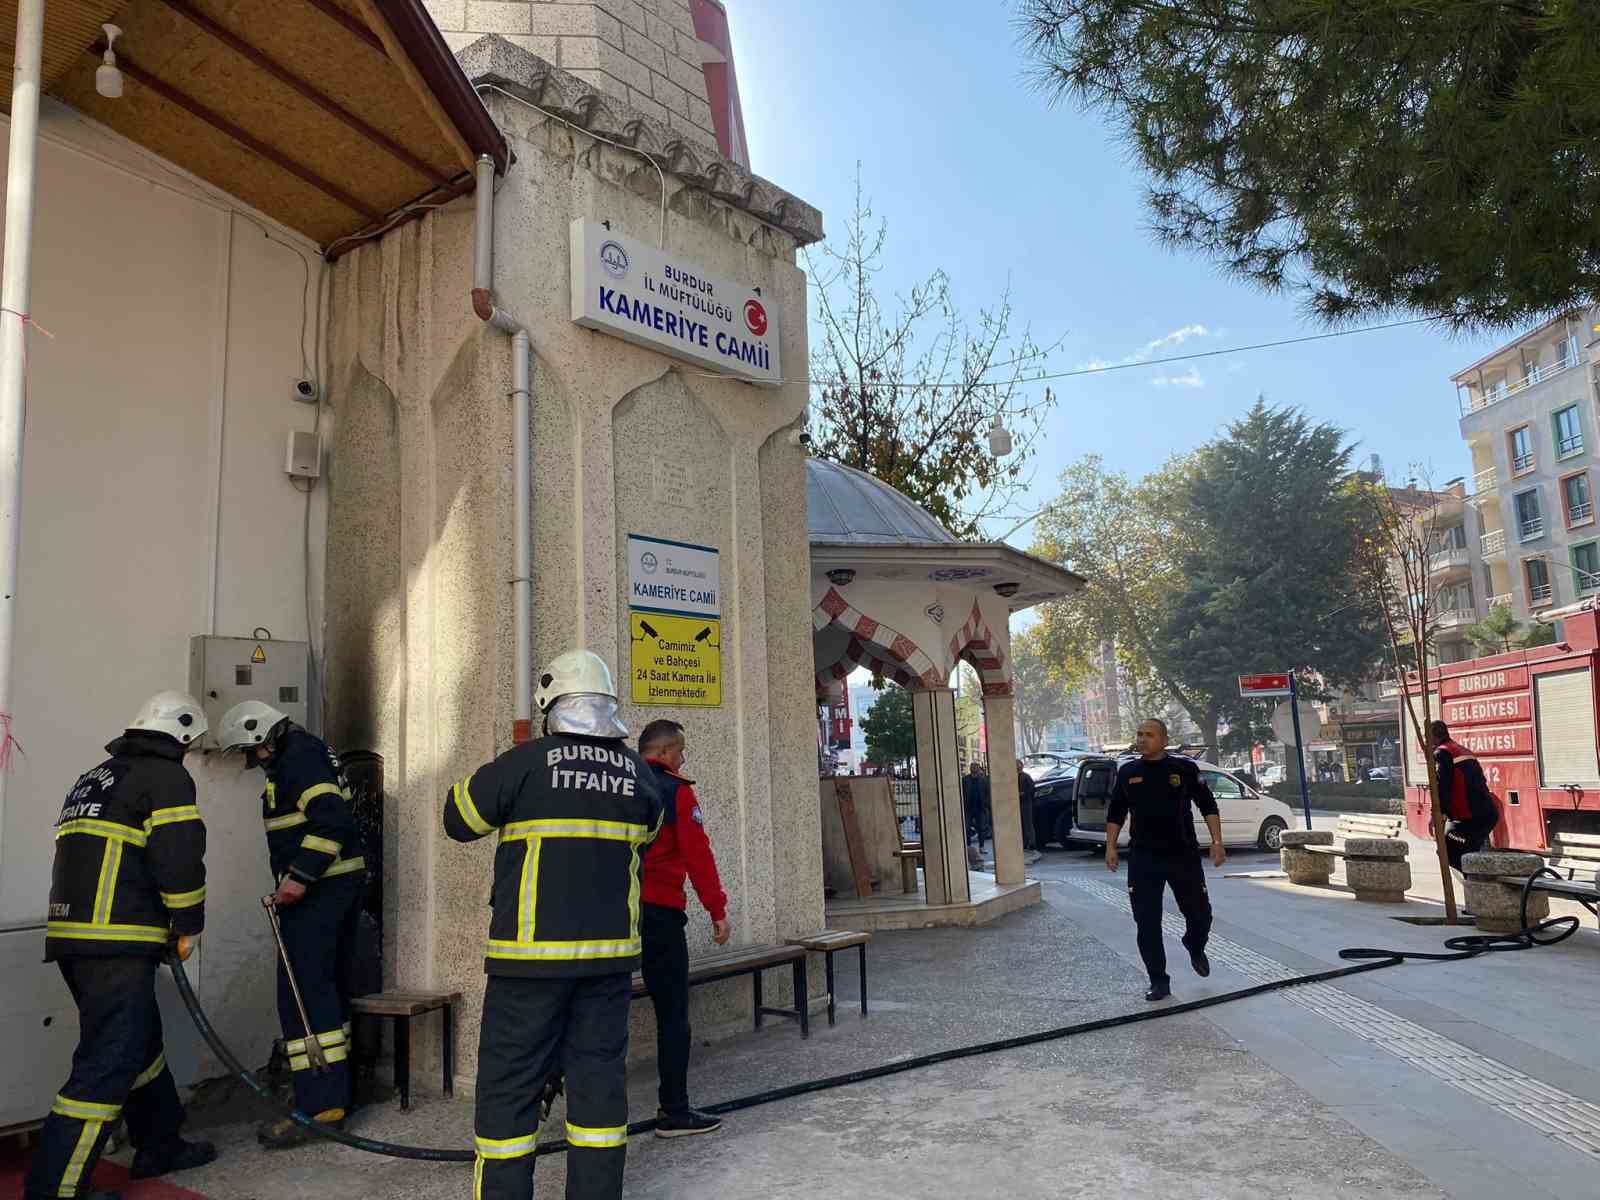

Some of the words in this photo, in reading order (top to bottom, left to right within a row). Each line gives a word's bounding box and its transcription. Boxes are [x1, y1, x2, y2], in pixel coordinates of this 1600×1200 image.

[665, 265, 713, 297] BURDUR
[644, 272, 655, 292] İL
[659, 282, 732, 322] MÜFTÜLÜĞÜ
[599, 286, 708, 348] KAMERİYE
[715, 332, 769, 370] CAMİİ
[633, 582, 687, 602] KAMERİYE
[690, 589, 716, 606] CAMİİ
[659, 639, 696, 653] Camimiz
[654, 657, 664, 665] ve
[666, 655, 701, 669] Bahçesi
[637, 669, 648, 681] 24
[651, 671, 670, 681] Saat
[672, 671, 704, 683] Kamera
[1458, 672, 1505, 692] BURDUR
[1452, 701, 1519, 721] BELEDİYESİ
[547, 745, 638, 777] BURDUR
[552, 766, 635, 797] İTFAİYE
